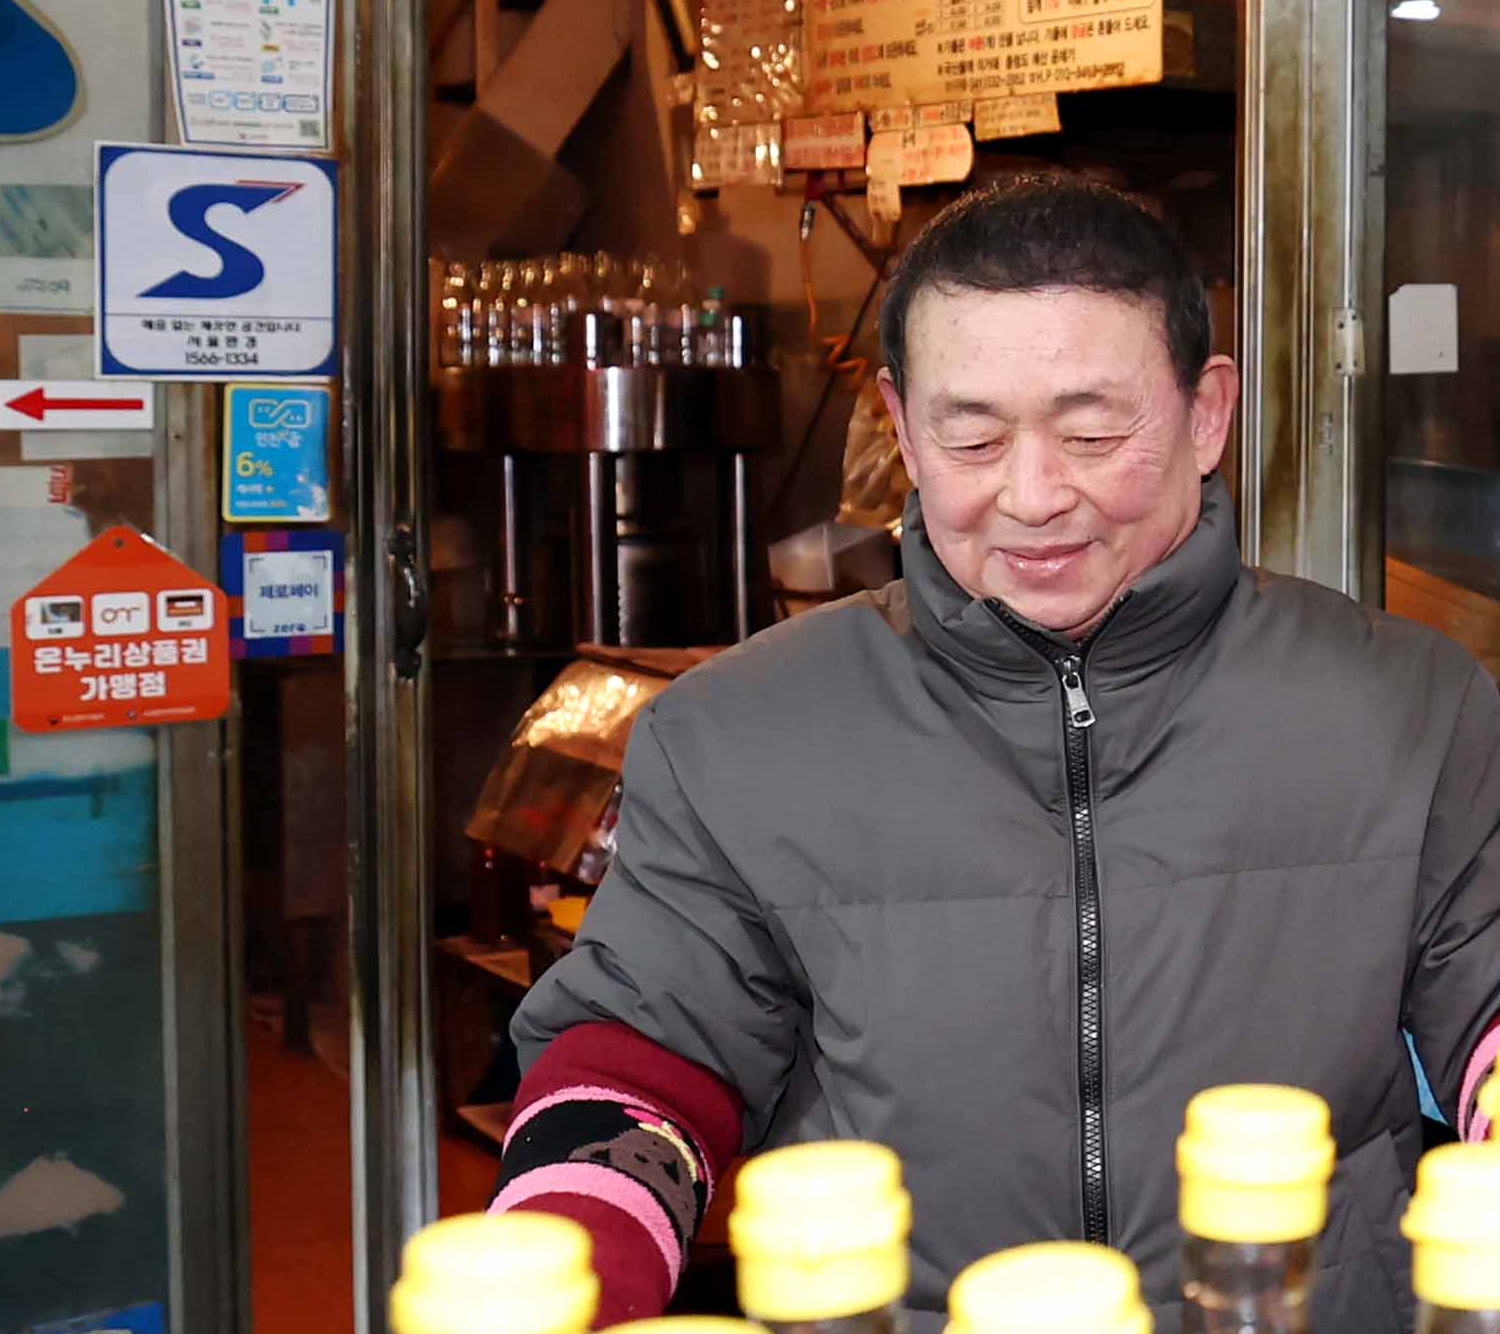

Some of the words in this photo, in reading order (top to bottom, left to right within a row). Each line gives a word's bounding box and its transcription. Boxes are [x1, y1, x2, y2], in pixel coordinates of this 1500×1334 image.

[236, 451, 273, 477] 6%
[33, 636, 208, 675] 온누리상품권
[80, 672, 166, 702] 가맹점
